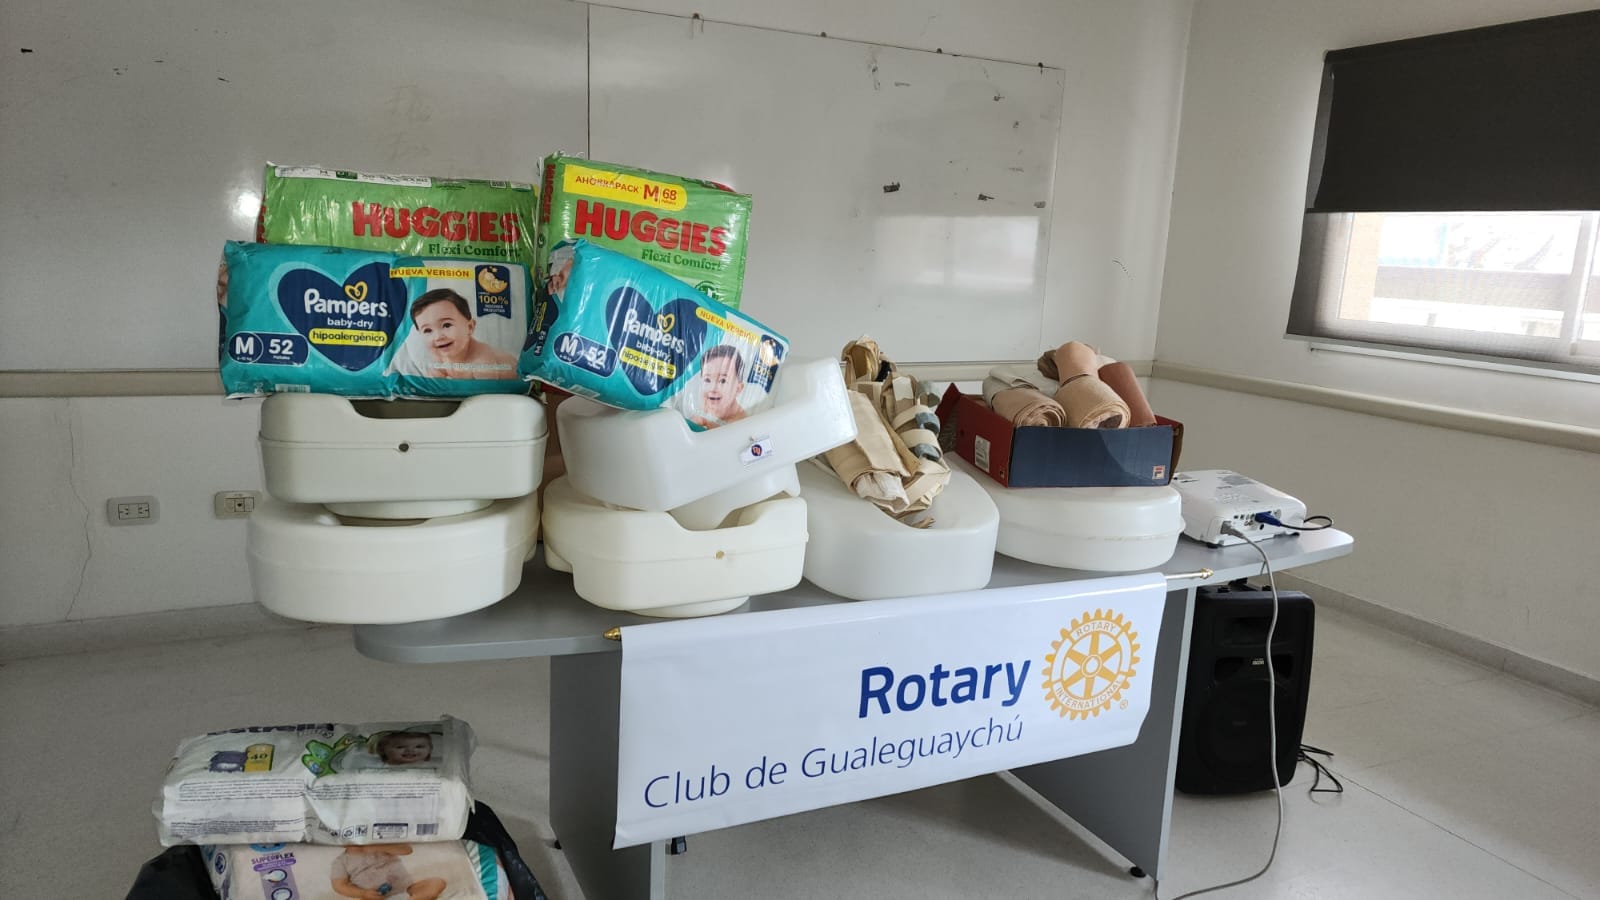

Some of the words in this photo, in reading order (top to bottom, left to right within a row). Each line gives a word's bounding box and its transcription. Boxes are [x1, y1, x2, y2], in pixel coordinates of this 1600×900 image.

[575, 175, 640, 193] AHORRAPACK
[643, 184, 660, 202] M
[662, 188, 678, 201] 68
[352, 201, 521, 243] HUGGIES
[574, 199, 727, 257] HUGGIES
[428, 243, 461, 256] Flexi
[463, 245, 521, 258] Comfort
[641, 248, 671, 265] Flexi
[673, 254, 722, 272] Comfort
[390, 268, 424, 277] NUEVA
[303, 288, 389, 318] Pampers
[479, 295, 509, 305] 100%
[327, 317, 374, 329] baby-dry
[623, 308, 685, 354] Pampers
[700, 310, 725, 328] NUEVA
[235, 336, 255, 355] M
[268, 338, 294, 355] 52
[560, 335, 579, 357] M
[586, 346, 607, 366] 52
[1075, 621, 1117, 637] ROTARY
[858, 659, 1031, 719] Rotary
[1055, 680, 1121, 710] INTERNATIONAL
[644, 765, 731, 808] Club
[745, 756, 788, 788] de
[801, 714, 1024, 779] Gualeguaychú
[251, 852, 295, 865] SUPERFLEX
